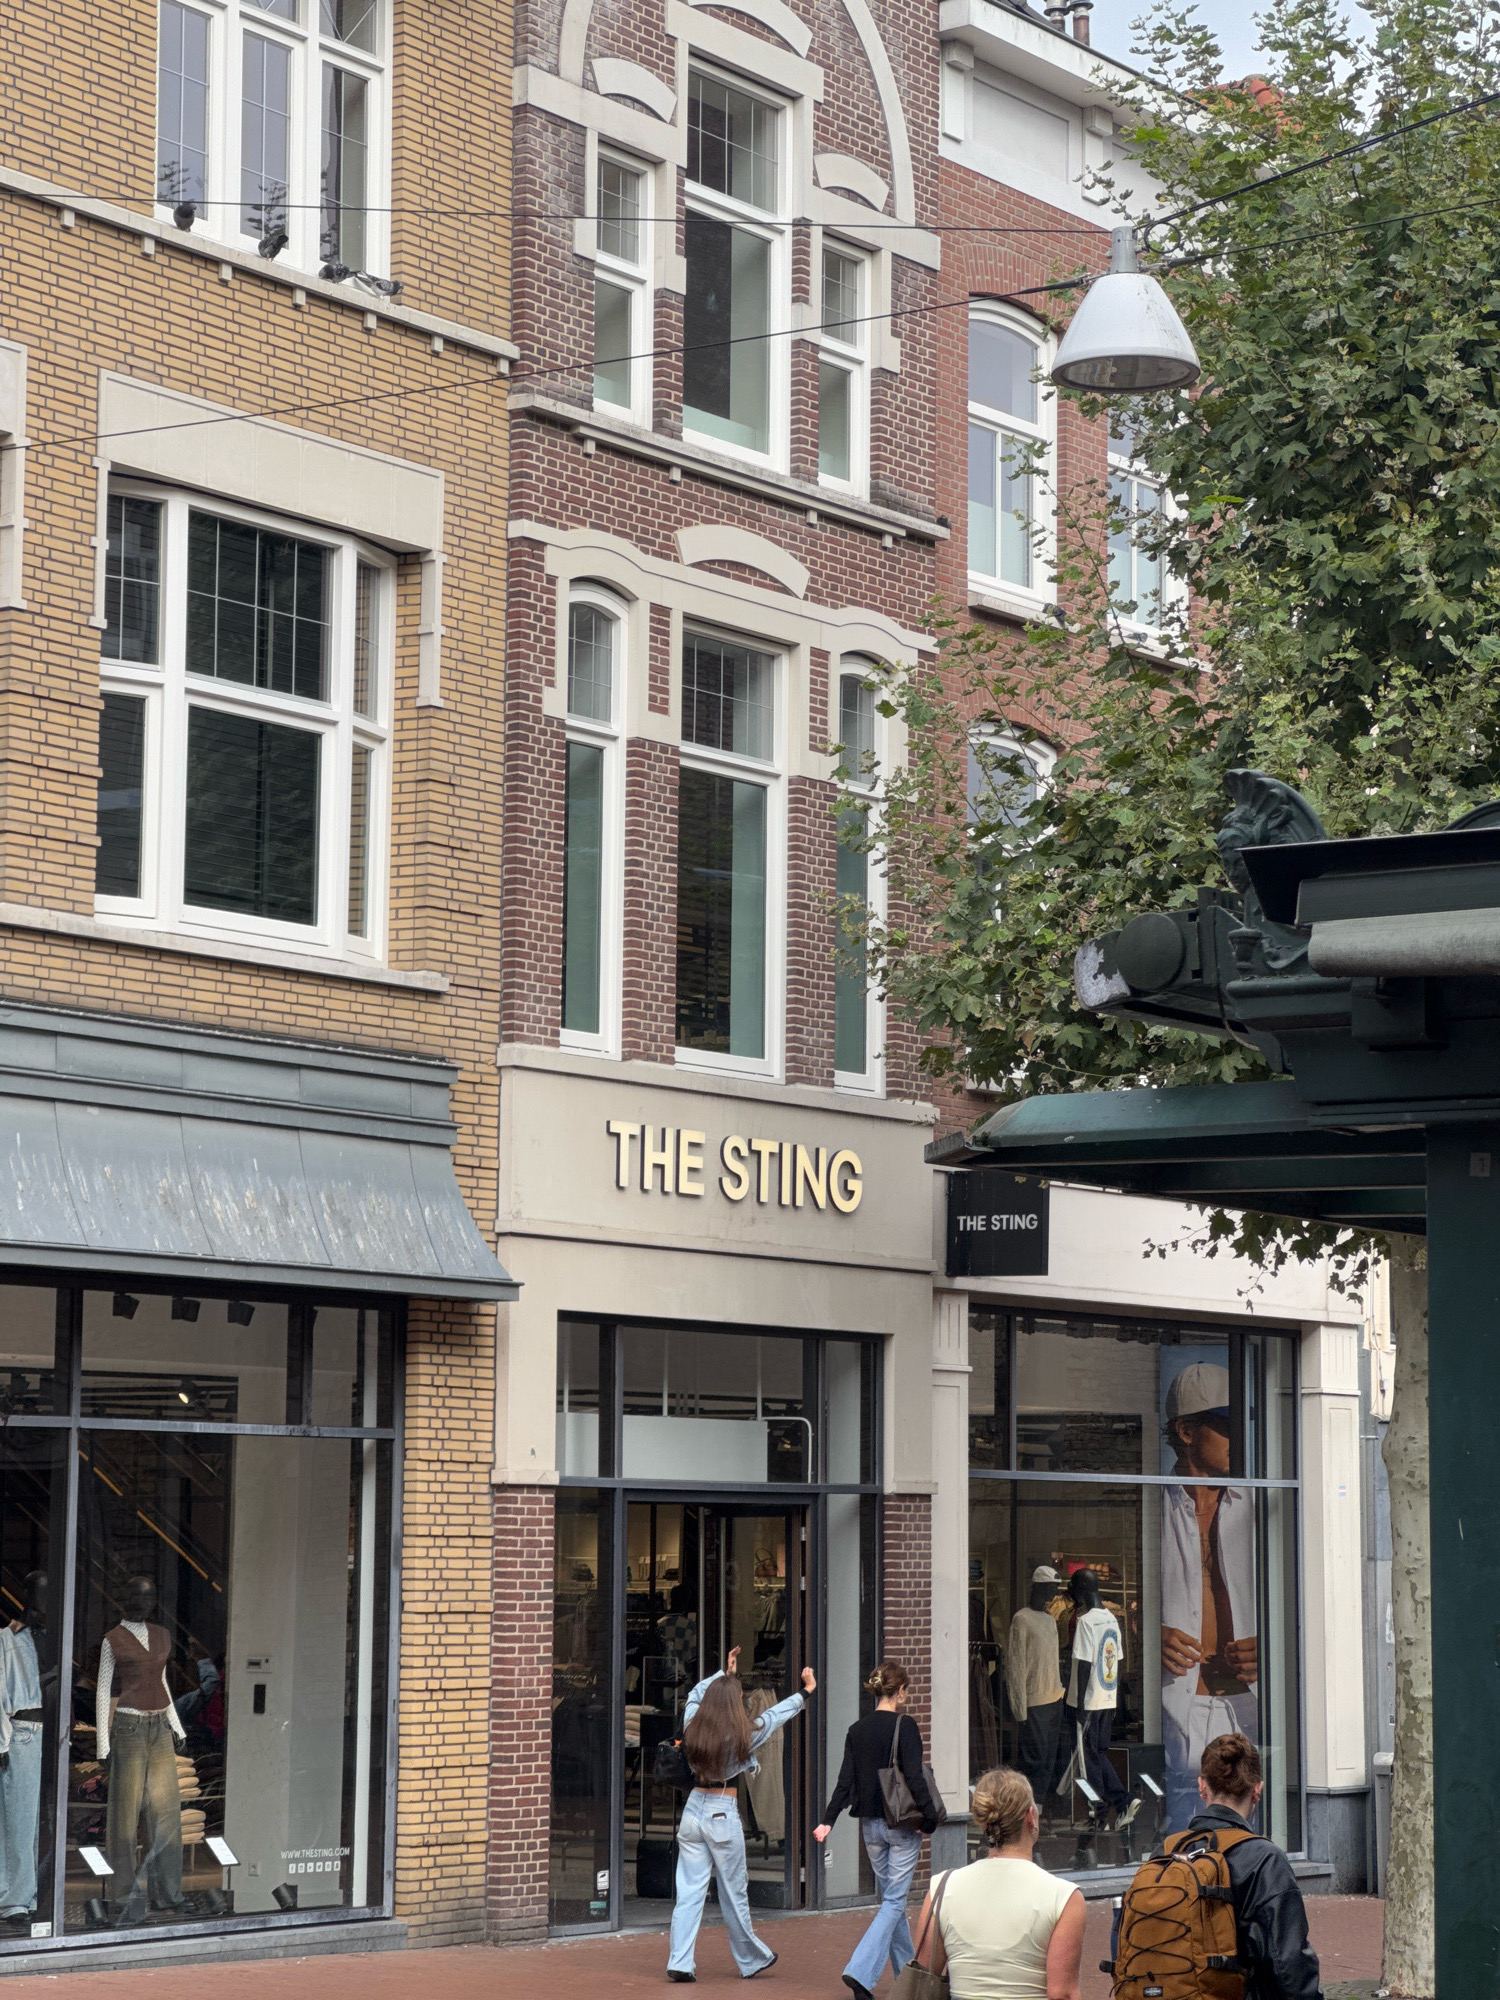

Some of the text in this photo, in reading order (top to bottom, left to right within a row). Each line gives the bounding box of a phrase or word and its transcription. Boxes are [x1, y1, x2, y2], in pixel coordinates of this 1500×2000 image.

[606, 1119, 863, 1213] THE STING
[957, 1213, 1038, 1231] THE STING
[280, 1847, 350, 1859] WWW.THESTING.COM
